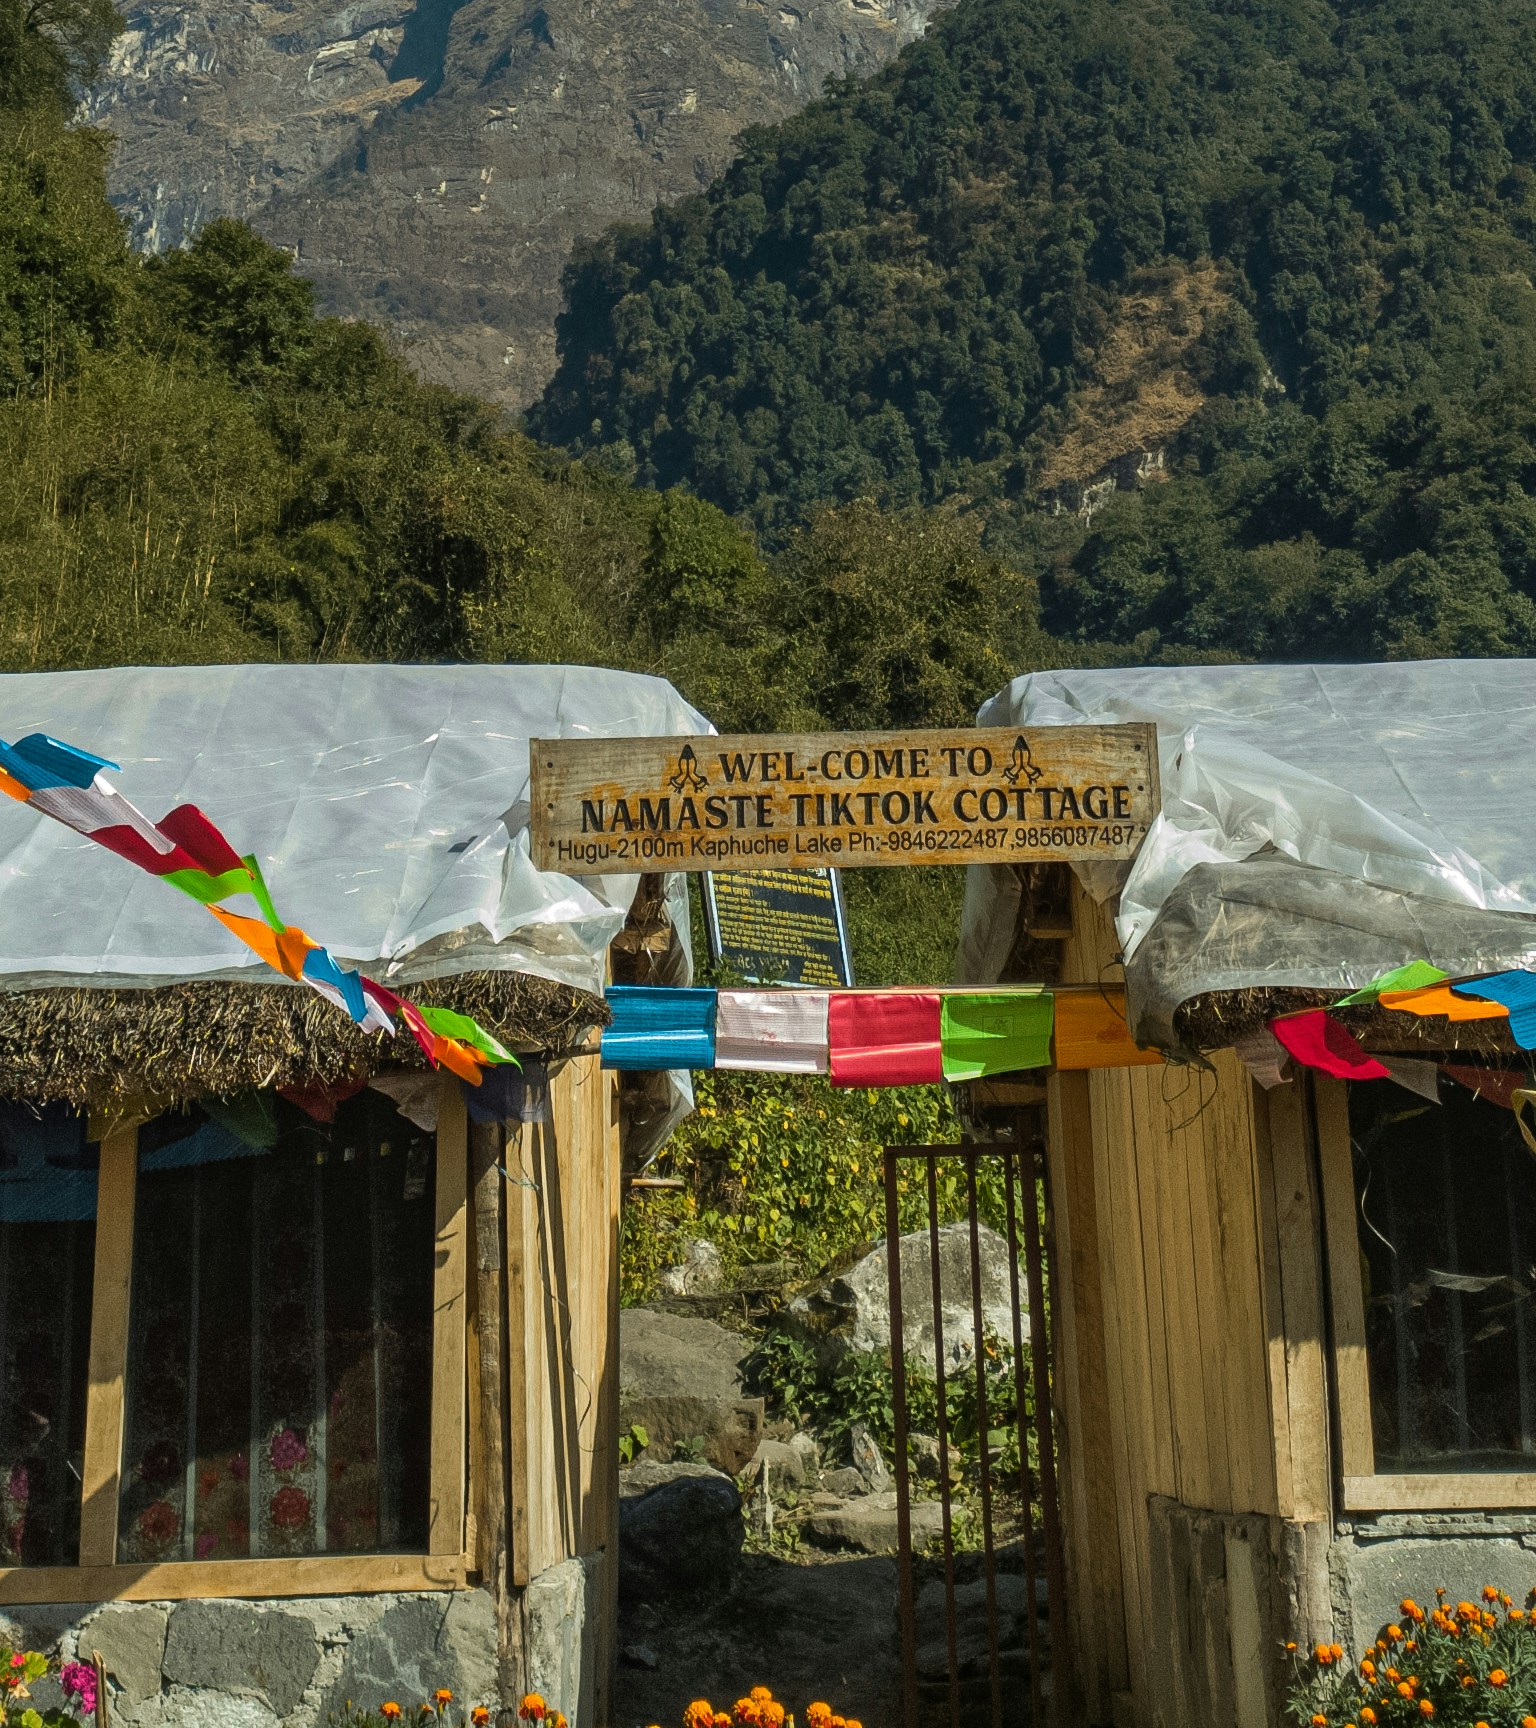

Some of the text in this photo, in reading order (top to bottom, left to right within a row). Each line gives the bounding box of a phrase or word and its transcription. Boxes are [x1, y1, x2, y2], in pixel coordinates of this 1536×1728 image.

[718, 746, 993, 783] WEL-COME TO
[580, 785, 1131, 834] NAMASTE TIKTOK COTTAGE
[558, 835, 684, 865] Hugu-2100m
[691, 833, 789, 860] Kaphuche
[795, 831, 843, 854] Lake
